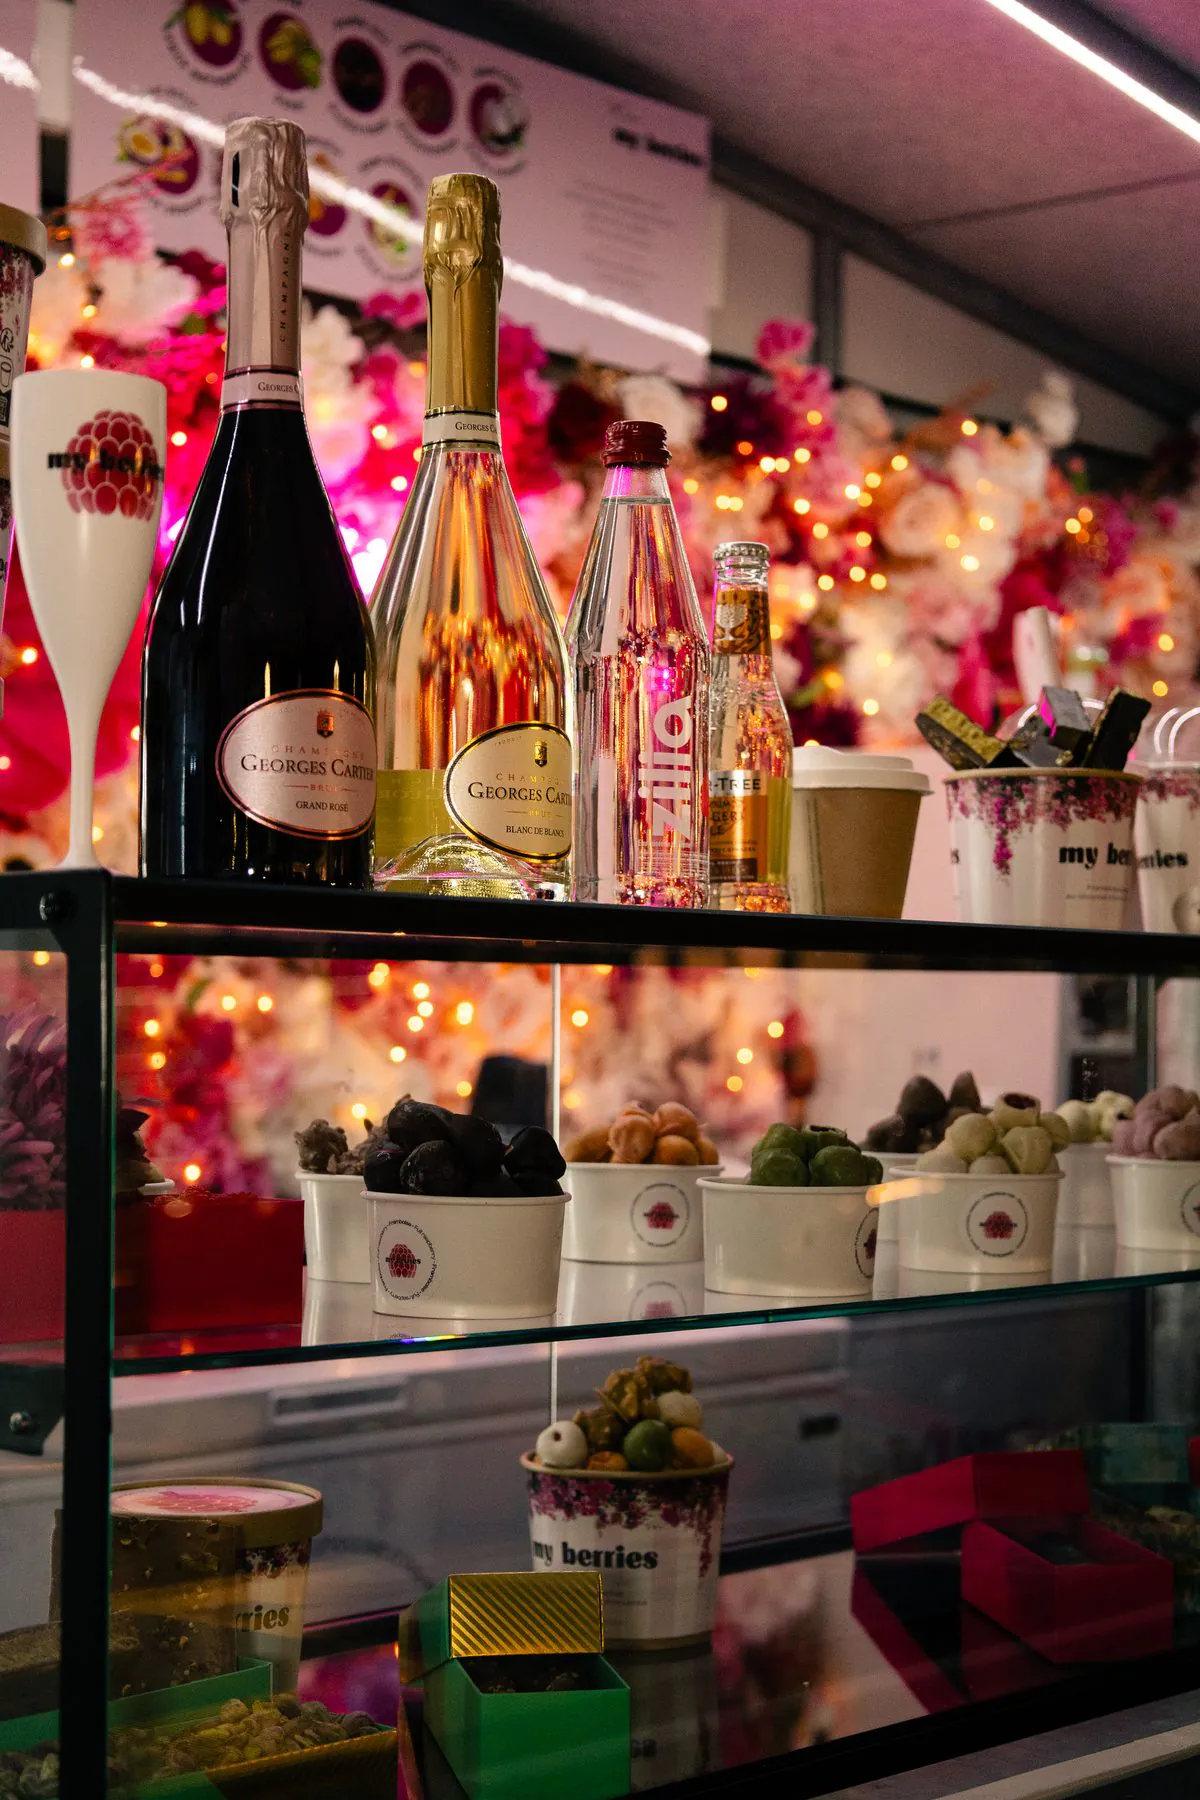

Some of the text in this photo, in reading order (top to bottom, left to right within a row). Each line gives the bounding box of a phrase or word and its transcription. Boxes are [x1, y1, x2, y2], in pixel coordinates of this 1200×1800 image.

[240, 754, 328, 776] GEORGES
[467, 781, 543, 802] GEORGES
[295, 801, 328, 812] GRAND
[505, 824, 533, 835] BLANC
[533, 826, 544, 835] DE
[1058, 846, 1099, 870] my
[562, 1541, 659, 1570] berries
